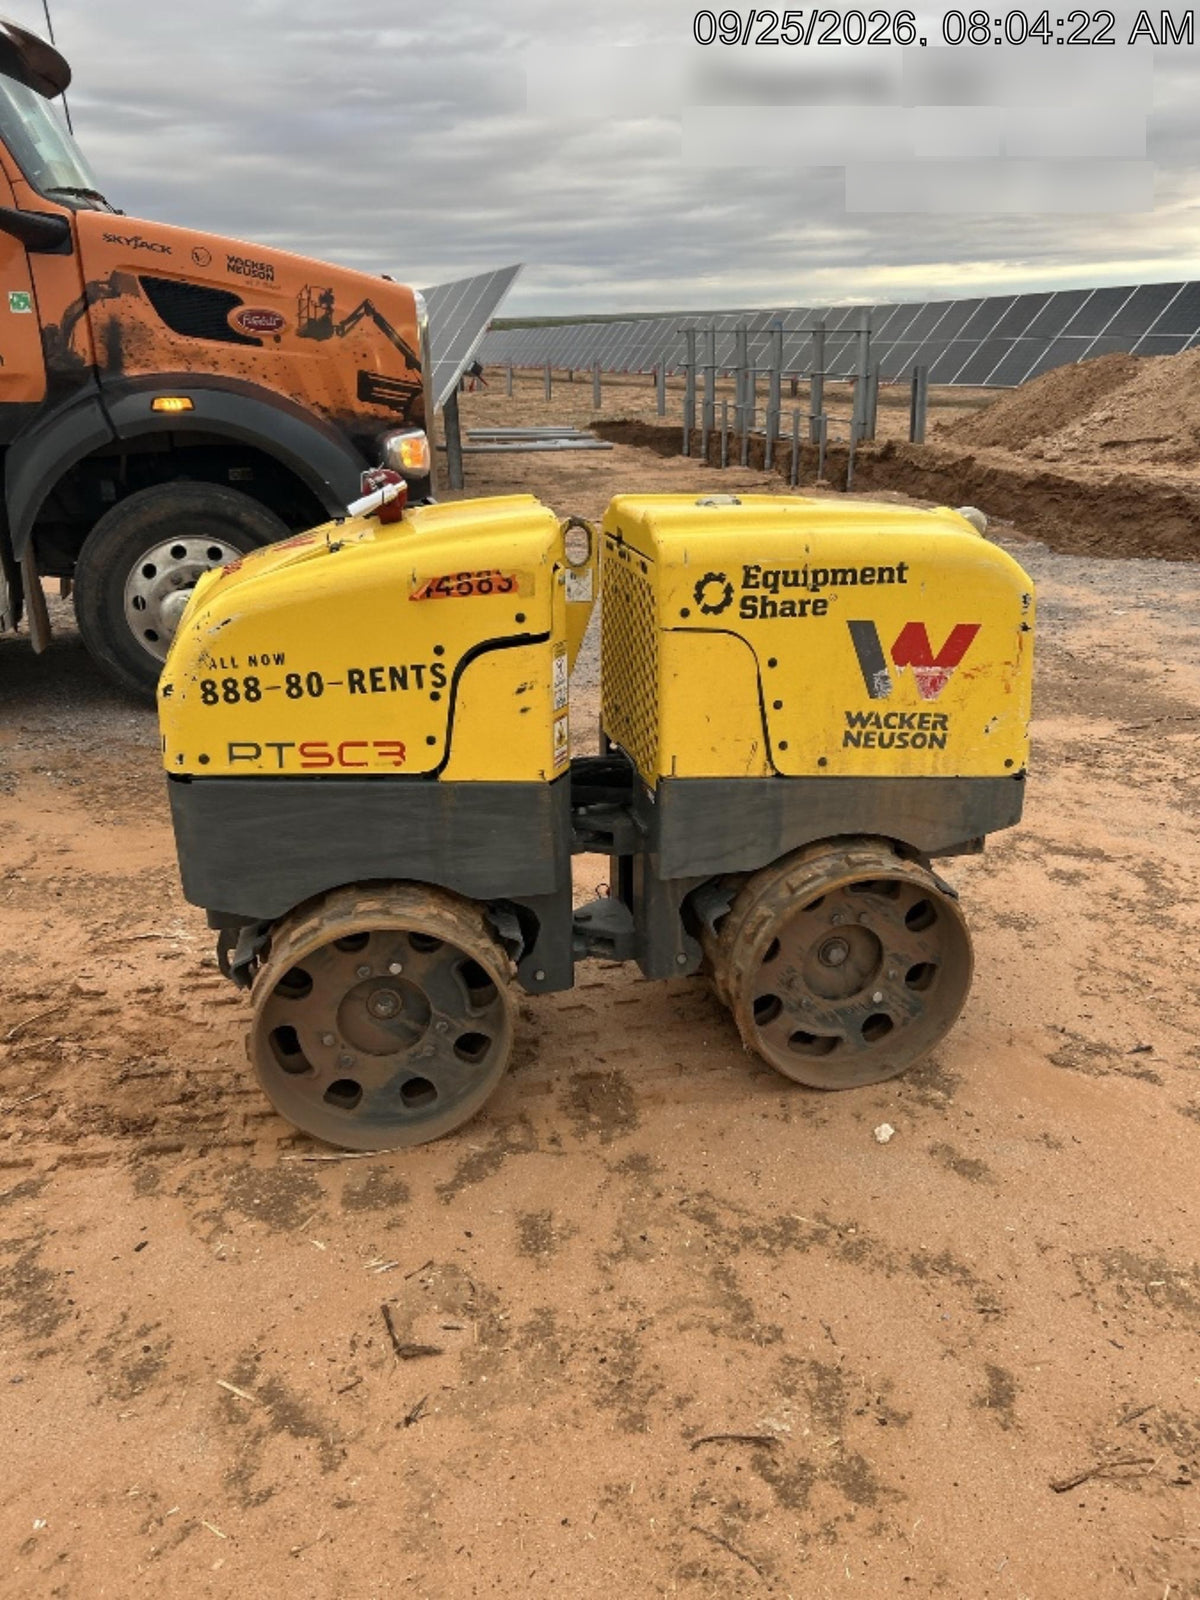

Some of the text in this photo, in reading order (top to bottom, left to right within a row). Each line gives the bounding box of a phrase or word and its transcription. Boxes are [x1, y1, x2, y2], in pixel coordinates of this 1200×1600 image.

[102, 232, 172, 255] SKYJACK
[226, 255, 275, 272] WACKER
[226, 263, 275, 282] NEUSON
[741, 561, 909, 594] Equipment
[739, 594, 829, 619] Share
[248, 652, 286, 668] NOW
[200, 662, 447, 706] 888-80-RENTS
[844, 711, 949, 731] WACKER
[842, 731, 948, 750] NEUSON
